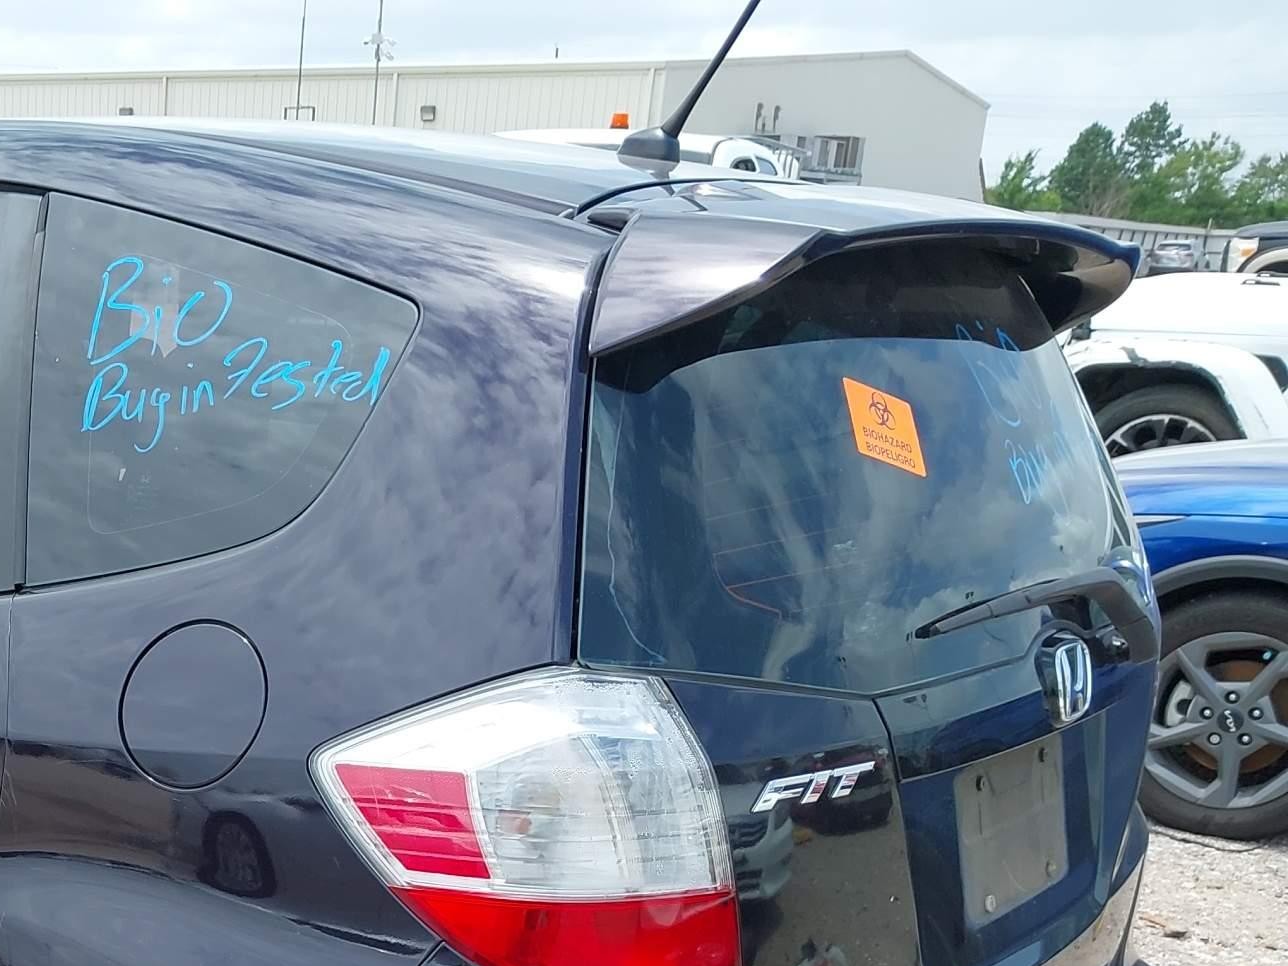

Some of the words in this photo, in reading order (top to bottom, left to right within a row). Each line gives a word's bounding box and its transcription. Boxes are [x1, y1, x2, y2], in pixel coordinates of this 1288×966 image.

[862, 425, 913, 454] BIOHAZARD
[865, 441, 916, 469] BIOPELIGRO
[750, 760, 876, 813] FIT
